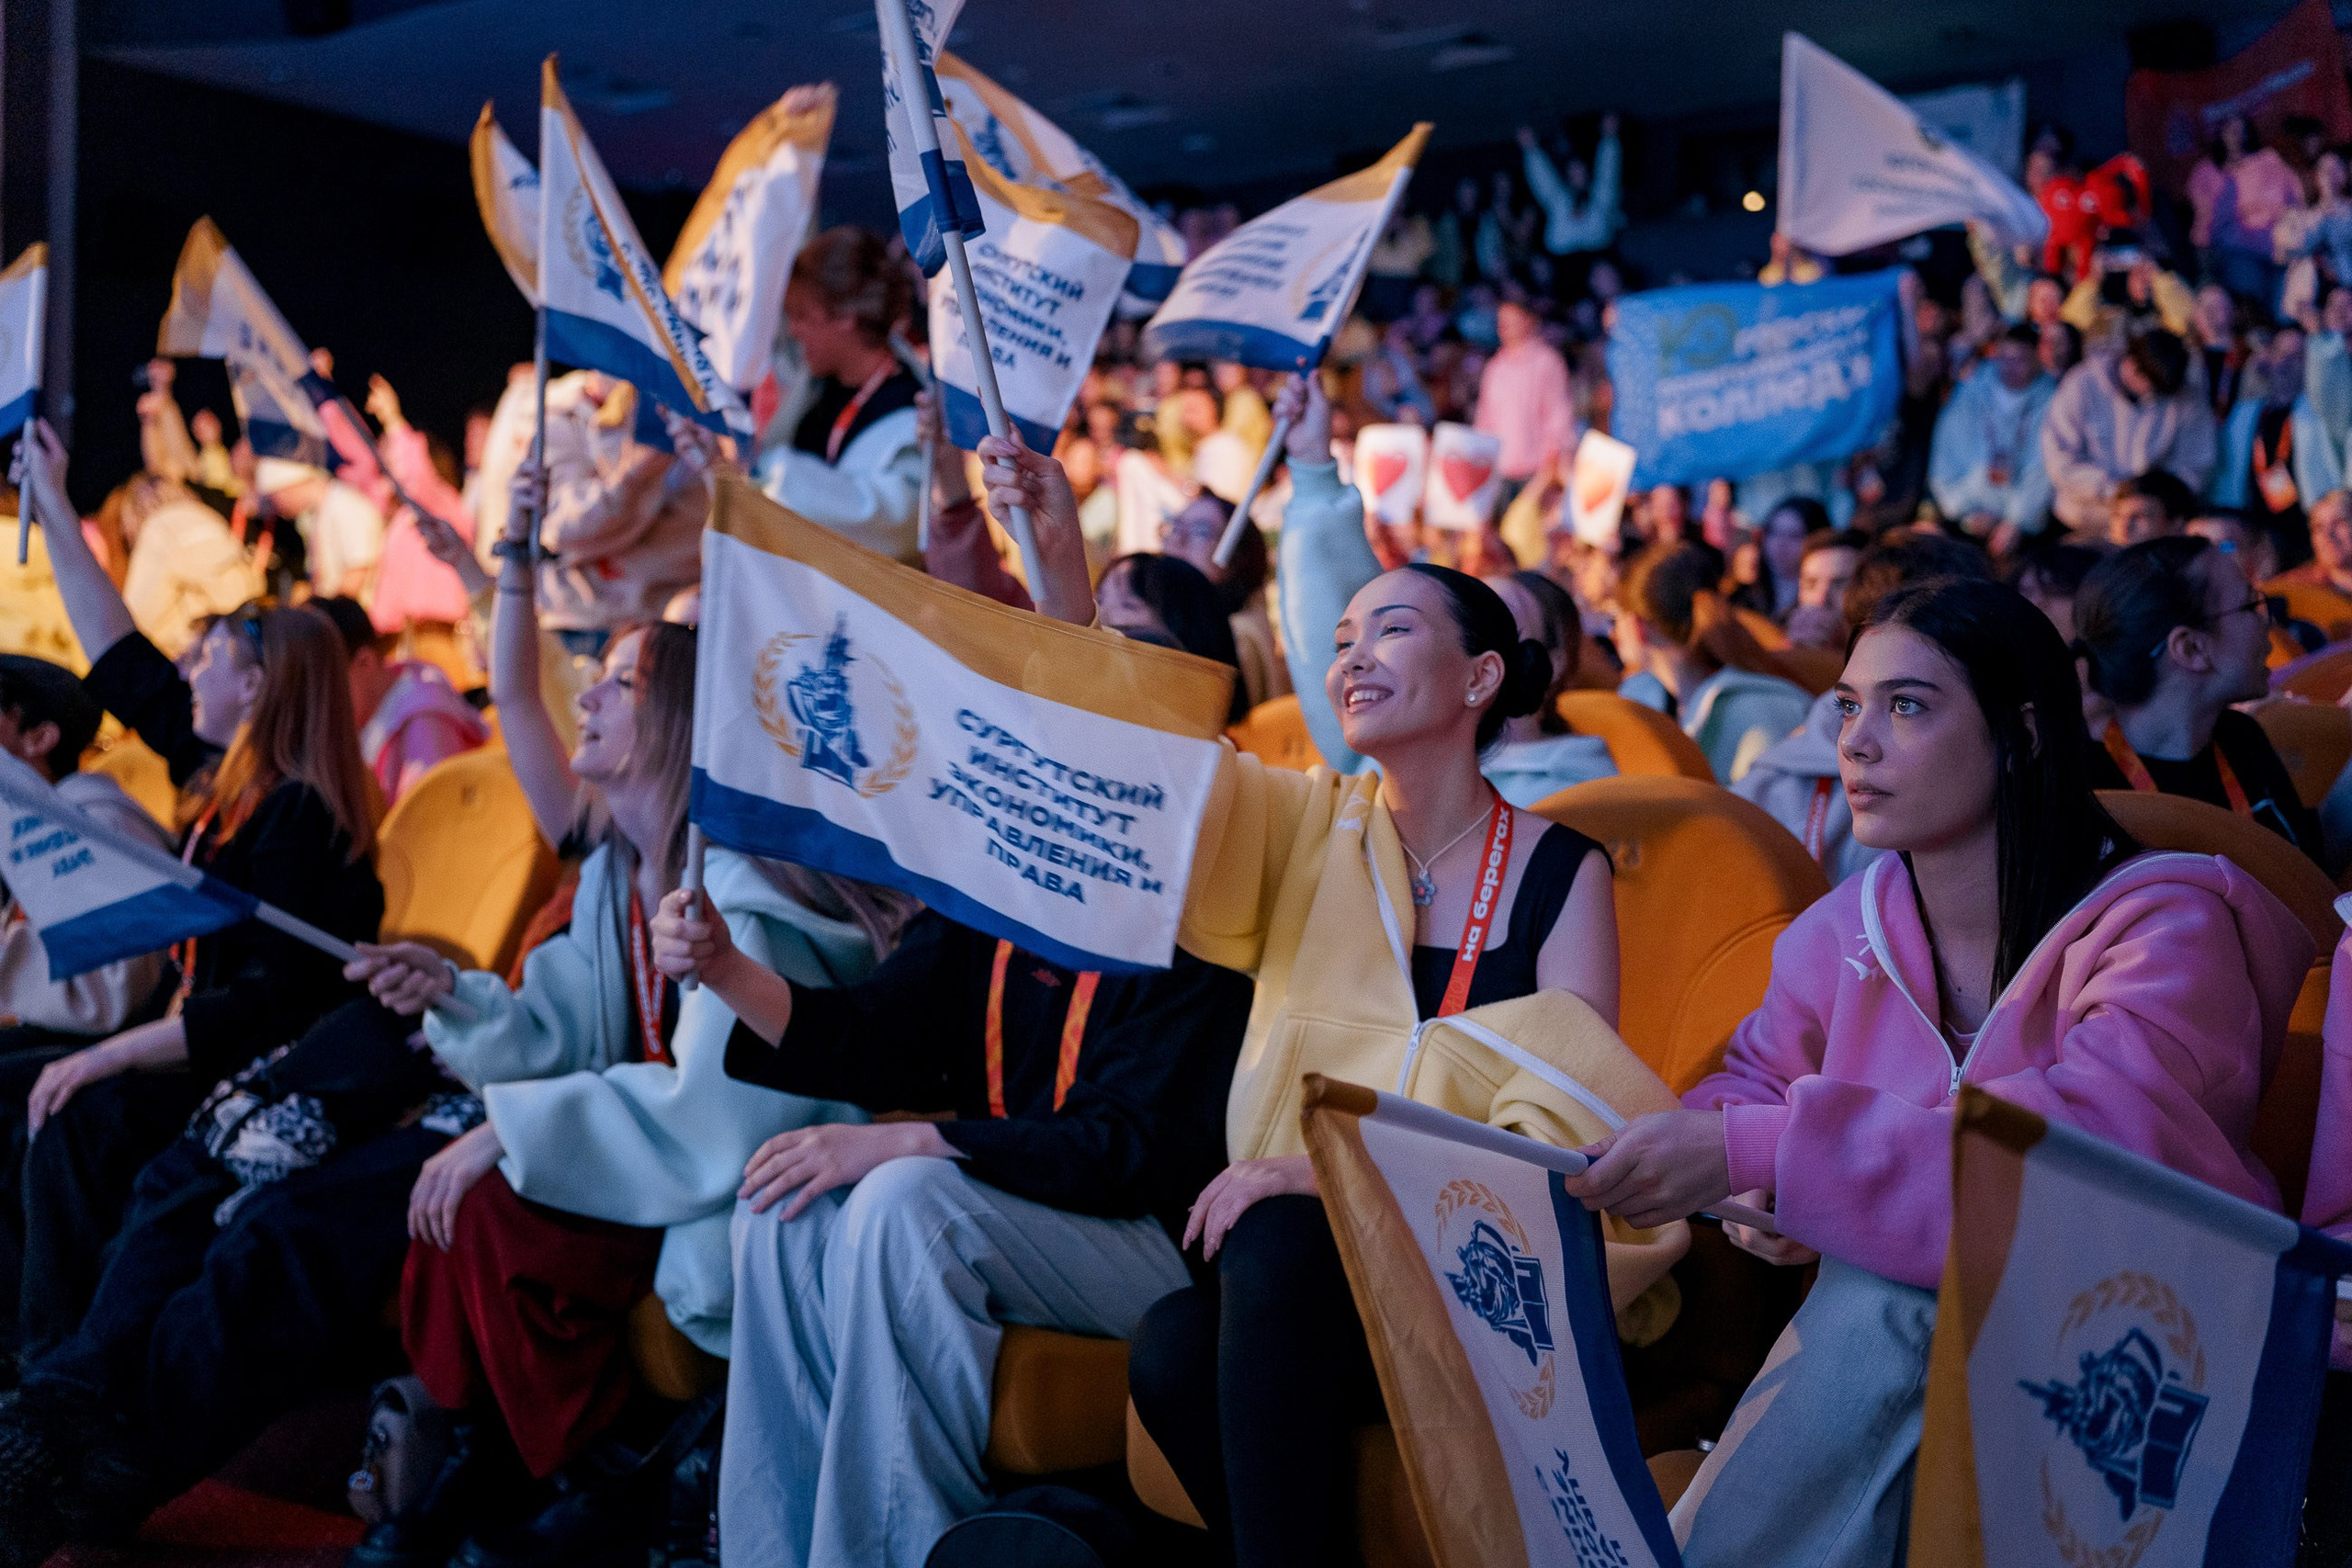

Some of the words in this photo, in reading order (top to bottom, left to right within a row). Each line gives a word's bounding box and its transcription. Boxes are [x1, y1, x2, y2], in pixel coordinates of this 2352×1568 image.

[956, 708, 1166, 810] СУРГУТСКИЙ
[968, 745, 1137, 835] ИНСТИТУТ
[928, 776, 1134, 888] УПРАВЛЕНИЯ
[1140, 876, 1164, 895] И
[986, 837, 1087, 905] ПРАВА
[1462, 925, 1482, 963] на
[1473, 807, 1510, 920] берегах
